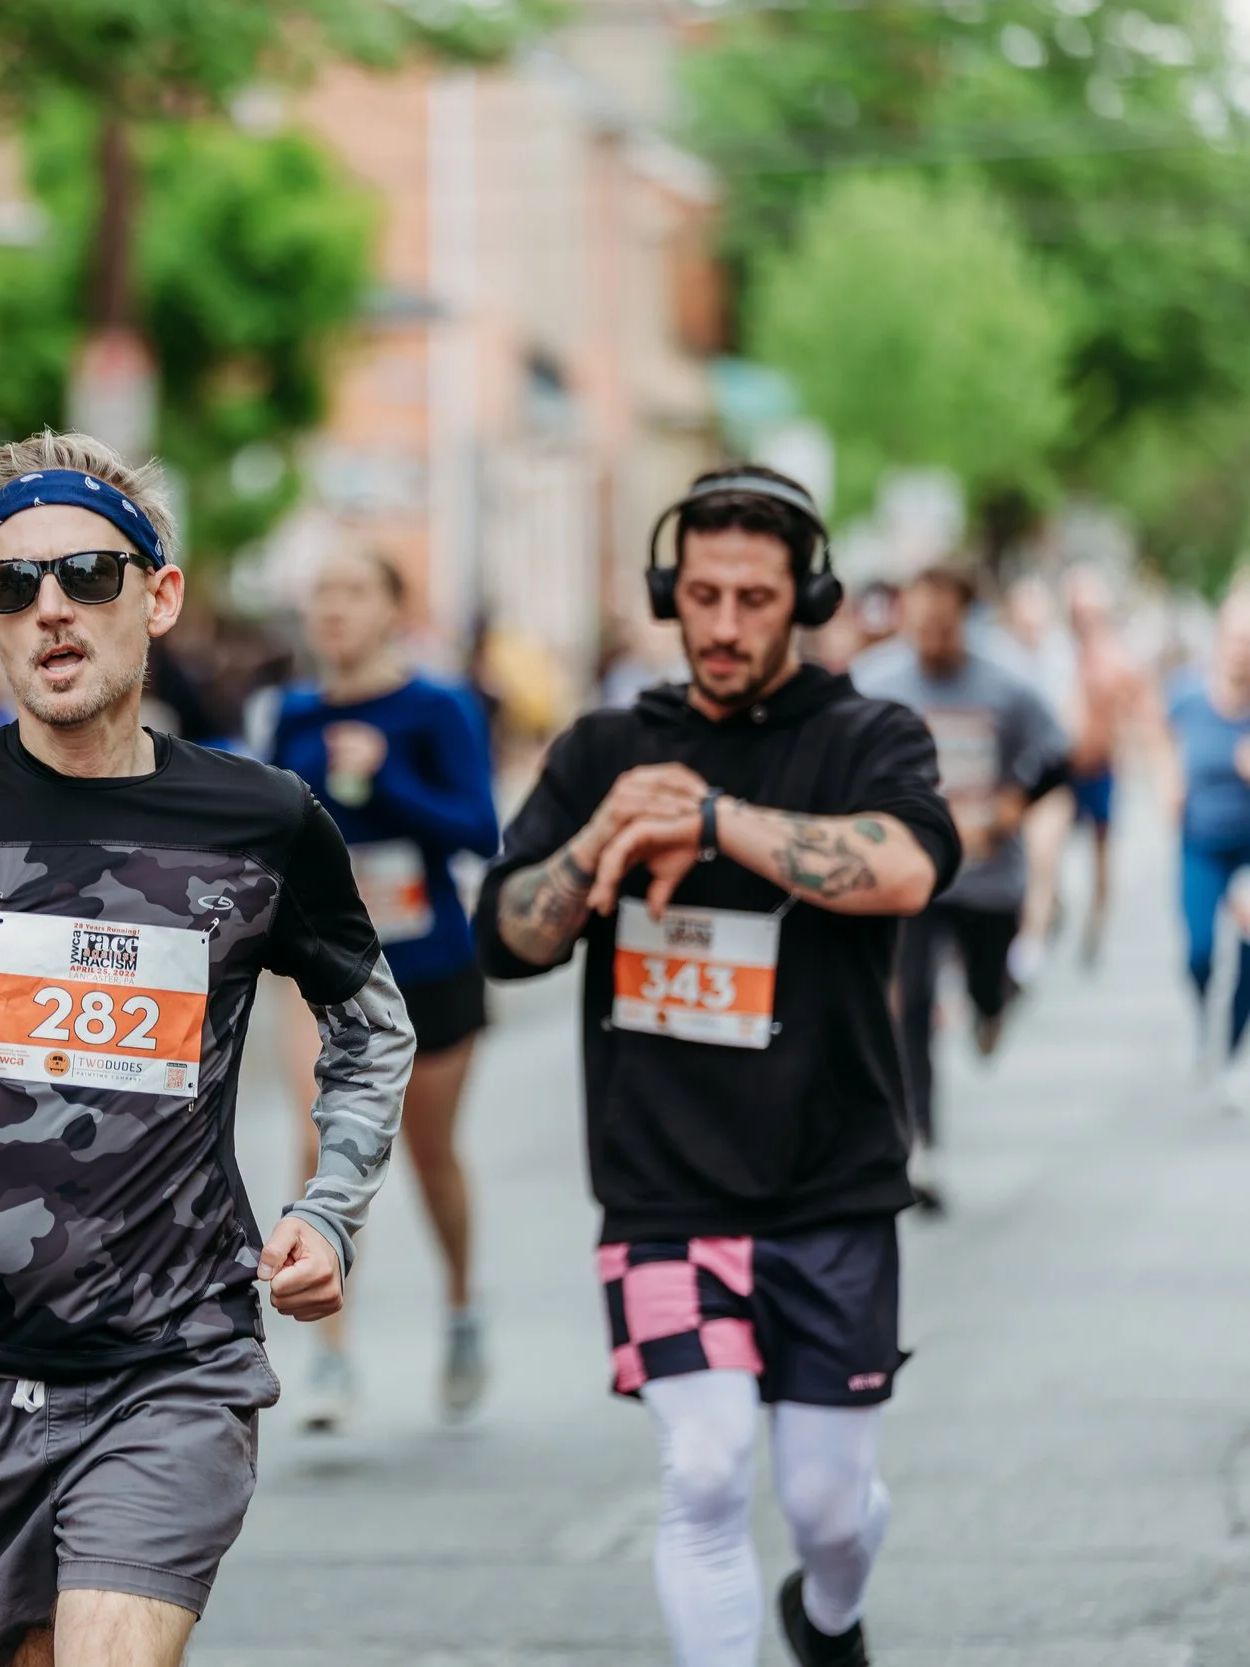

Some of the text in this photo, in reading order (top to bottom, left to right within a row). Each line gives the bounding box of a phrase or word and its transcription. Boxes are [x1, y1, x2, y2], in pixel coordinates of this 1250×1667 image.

[107, 927, 140, 935] Running!
[70, 930, 81, 964] ywca
[82, 934, 138, 953] race
[70, 965, 94, 973] APRIL
[80, 950, 137, 971] RACISM
[640, 957, 737, 1012] 343
[28, 986, 160, 1051] 282
